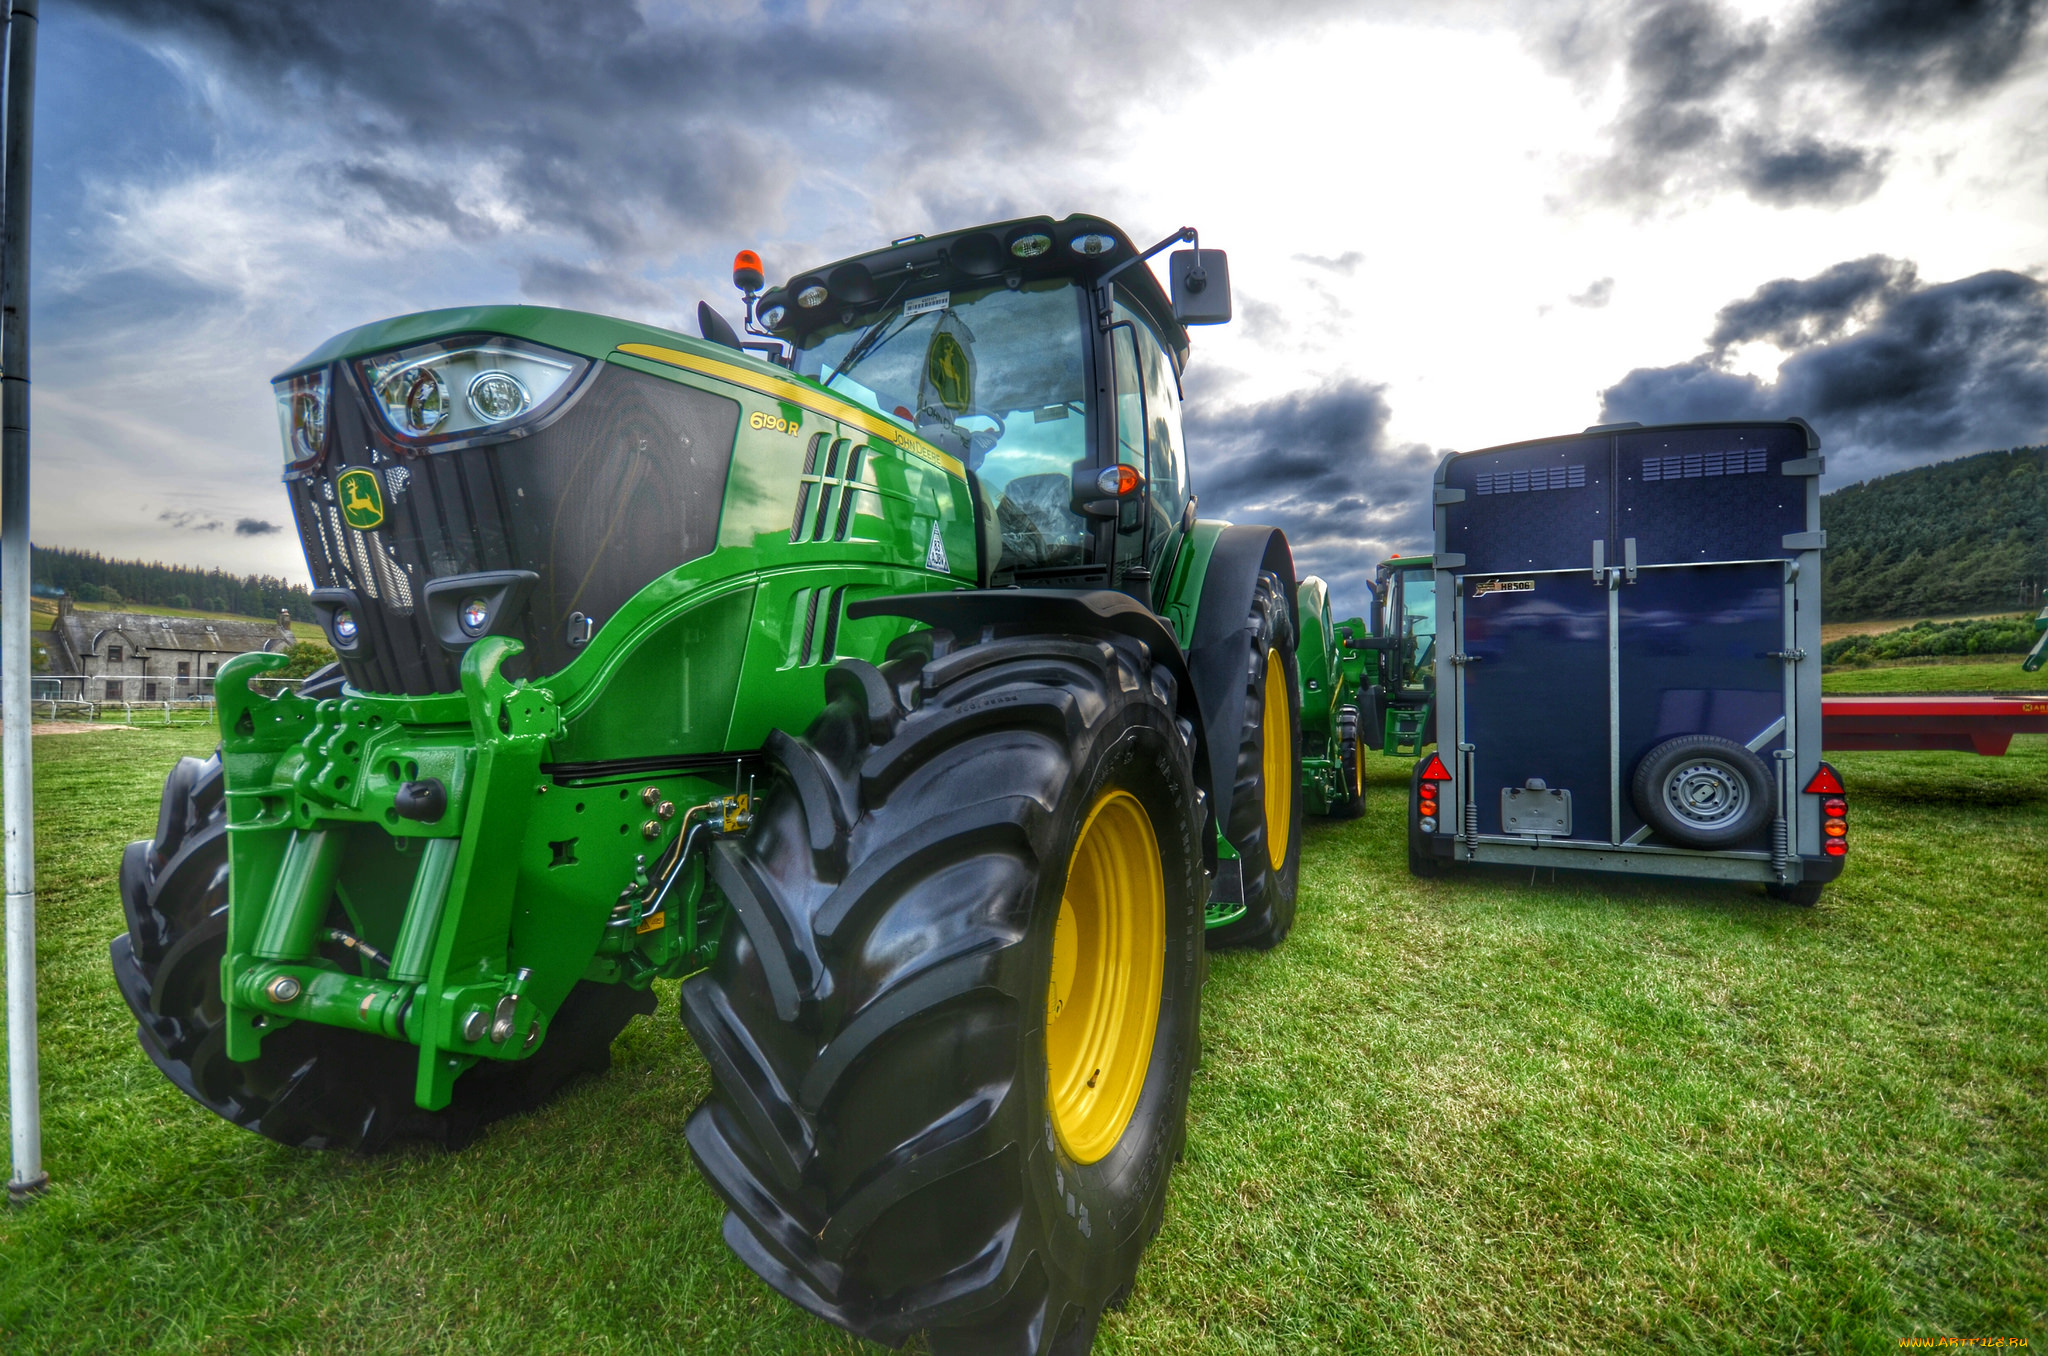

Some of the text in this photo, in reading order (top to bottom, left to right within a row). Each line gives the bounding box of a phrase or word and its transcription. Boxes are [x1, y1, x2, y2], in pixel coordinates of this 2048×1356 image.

[749, 411, 800, 437] 6190 R
[893, 429, 942, 464] JOHN DEERE
